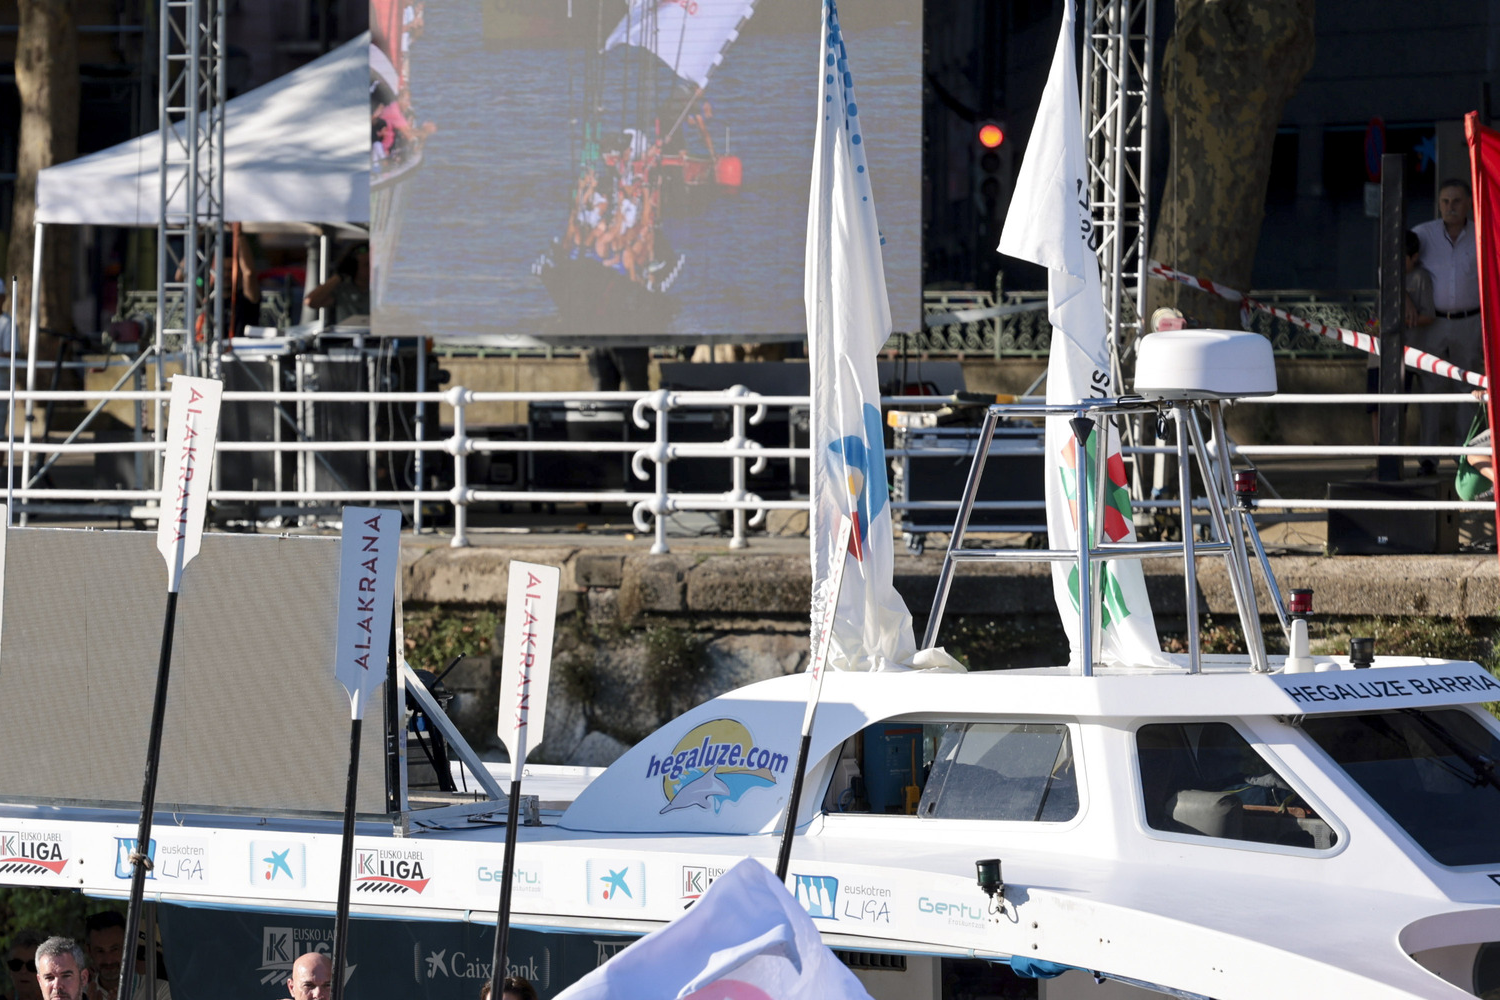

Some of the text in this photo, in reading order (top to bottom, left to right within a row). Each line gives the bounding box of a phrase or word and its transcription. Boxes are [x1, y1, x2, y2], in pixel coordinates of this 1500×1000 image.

[171, 387, 203, 544] ALAKRANA
[354, 513, 383, 671] ALAKRANA
[514, 571, 543, 731] ALAKRANA
[1284, 674, 1500, 703] HEGALUZE BARRIA
[645, 736, 789, 780] hegaluze.com
[21, 842, 62, 861] LIGA
[162, 844, 204, 856] euskotren
[162, 858, 204, 880] LIGA
[380, 861, 424, 879] LIGA
[844, 885, 891, 898] euskotren
[845, 900, 891, 924] LIGA
[451, 951, 539, 981] CaixBank
